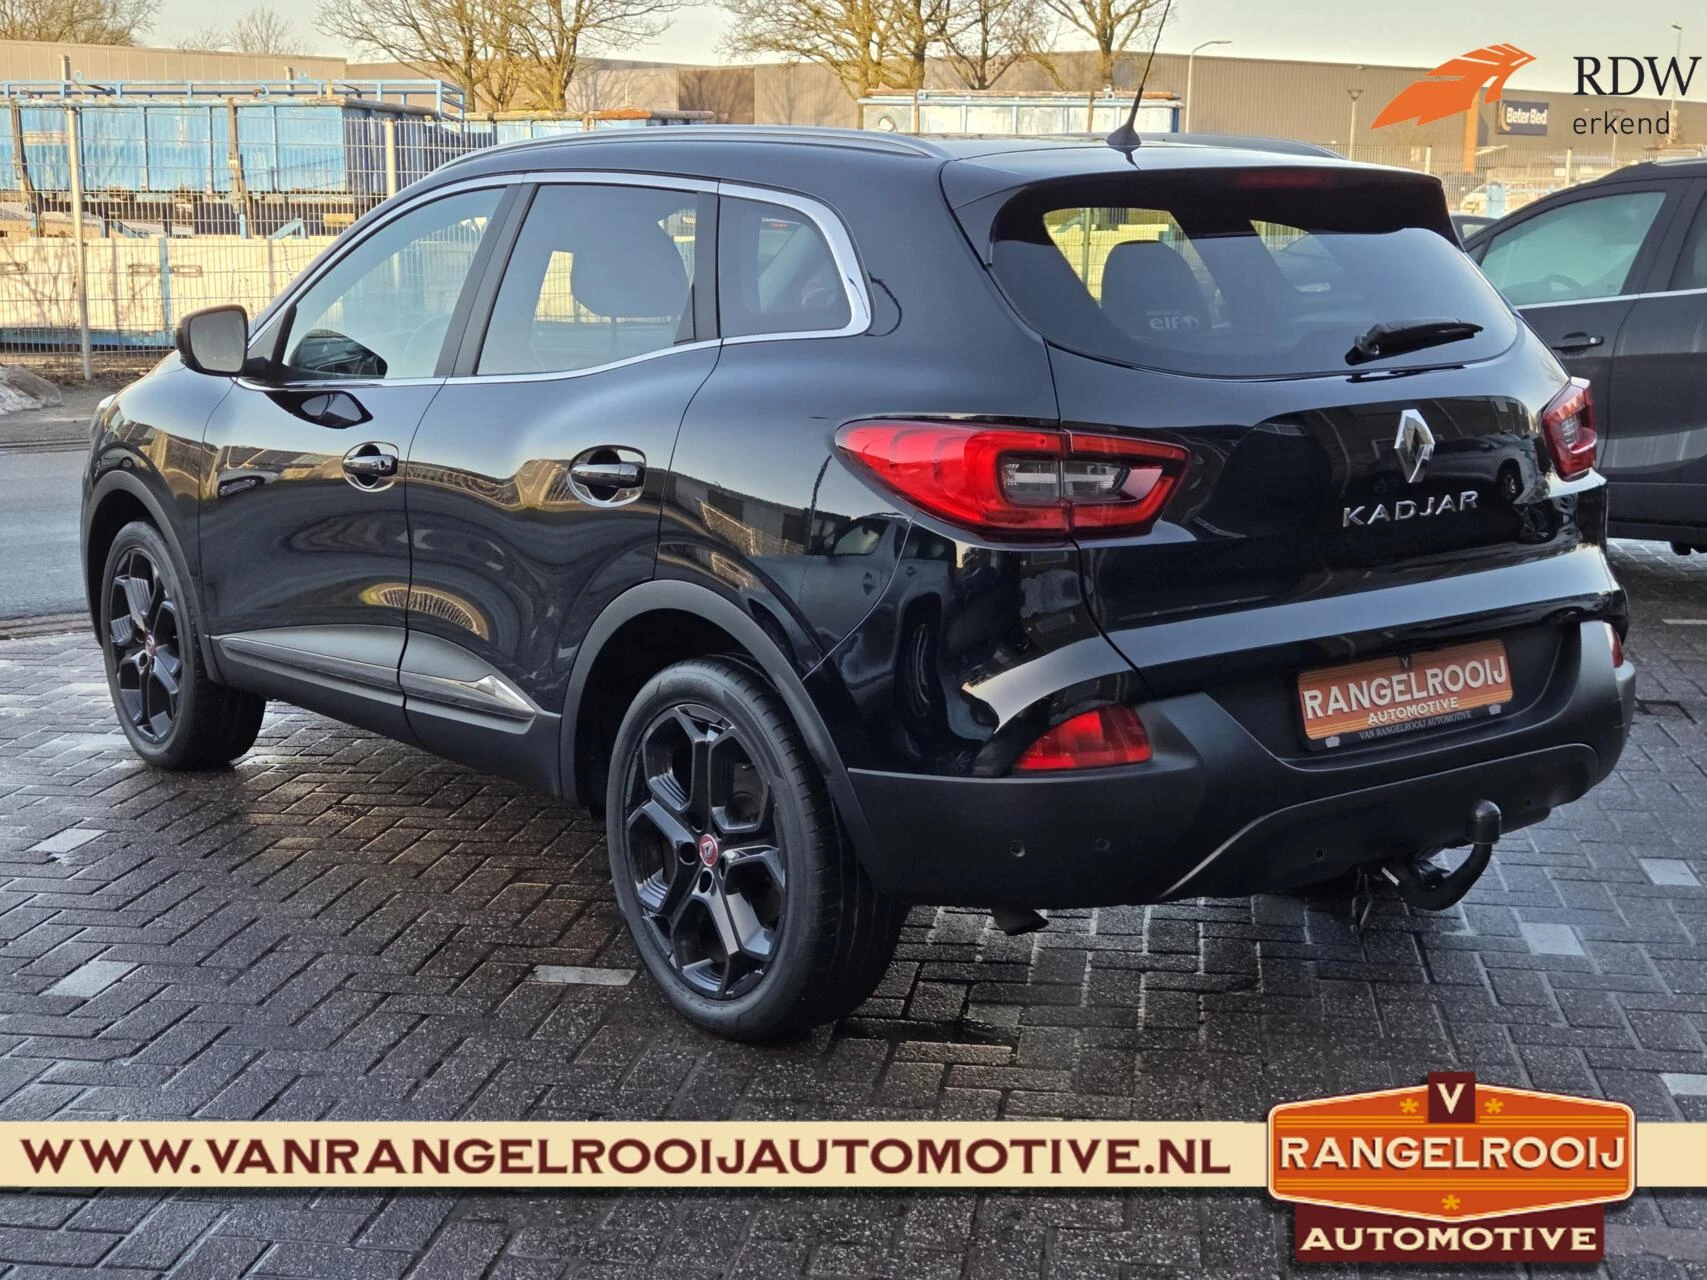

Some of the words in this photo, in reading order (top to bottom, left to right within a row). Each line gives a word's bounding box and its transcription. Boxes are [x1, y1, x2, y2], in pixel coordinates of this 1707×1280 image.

[1506, 107, 1530, 123] Beter
[1530, 108, 1547, 125] Bed
[1343, 490, 1479, 528] KADJAR
[1303, 656, 1507, 720] RANGELROOIJ
[1359, 730, 1375, 740] VAN
[1428, 711, 1473, 729] AUTOMOTIVE
[1367, 697, 1460, 726] AUTOMOTIVE
